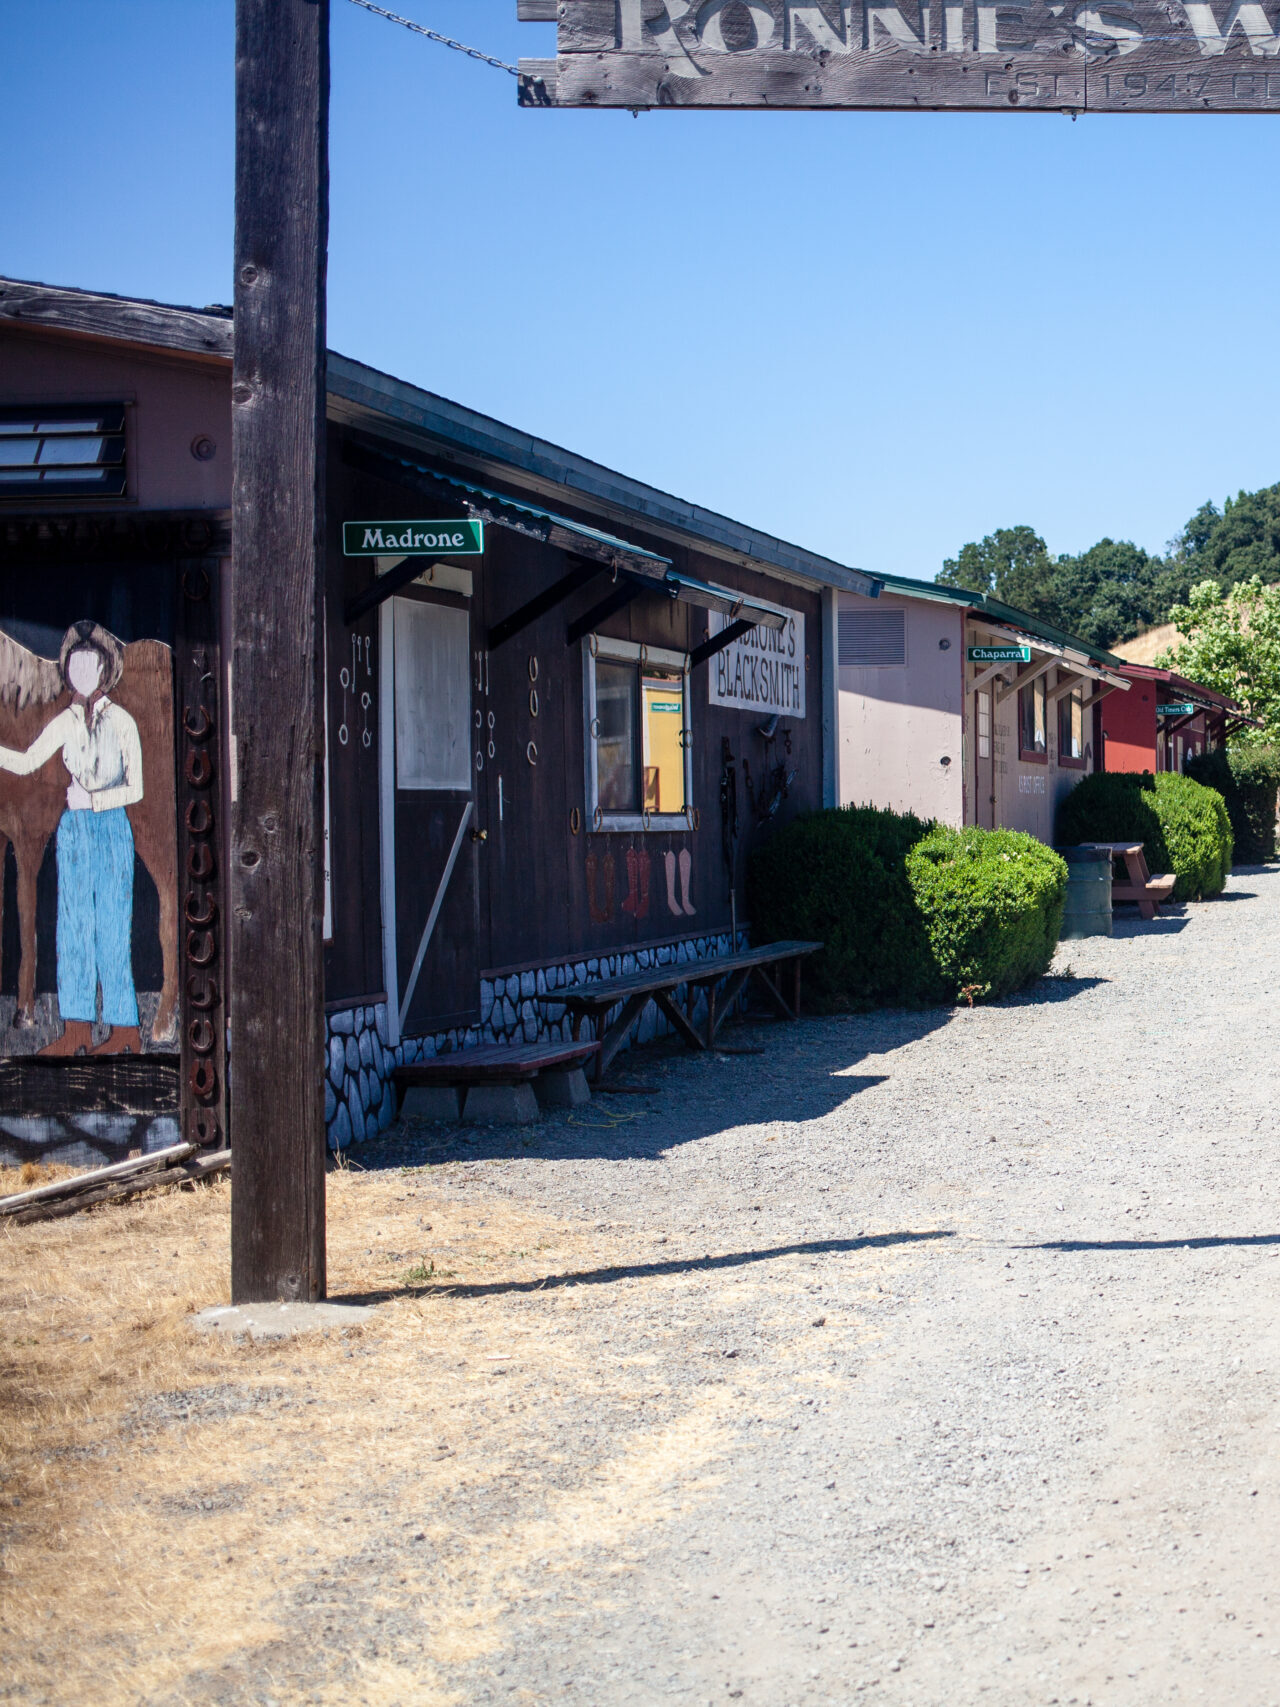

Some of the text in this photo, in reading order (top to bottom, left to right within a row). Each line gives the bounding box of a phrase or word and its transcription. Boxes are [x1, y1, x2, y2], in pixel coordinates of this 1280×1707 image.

[1101, 73, 1211, 99] 1947
[361, 528, 465, 549] Madrone
[972, 648, 1026, 660] Chaparral
[717, 648, 800, 710] BLACKSMITH
